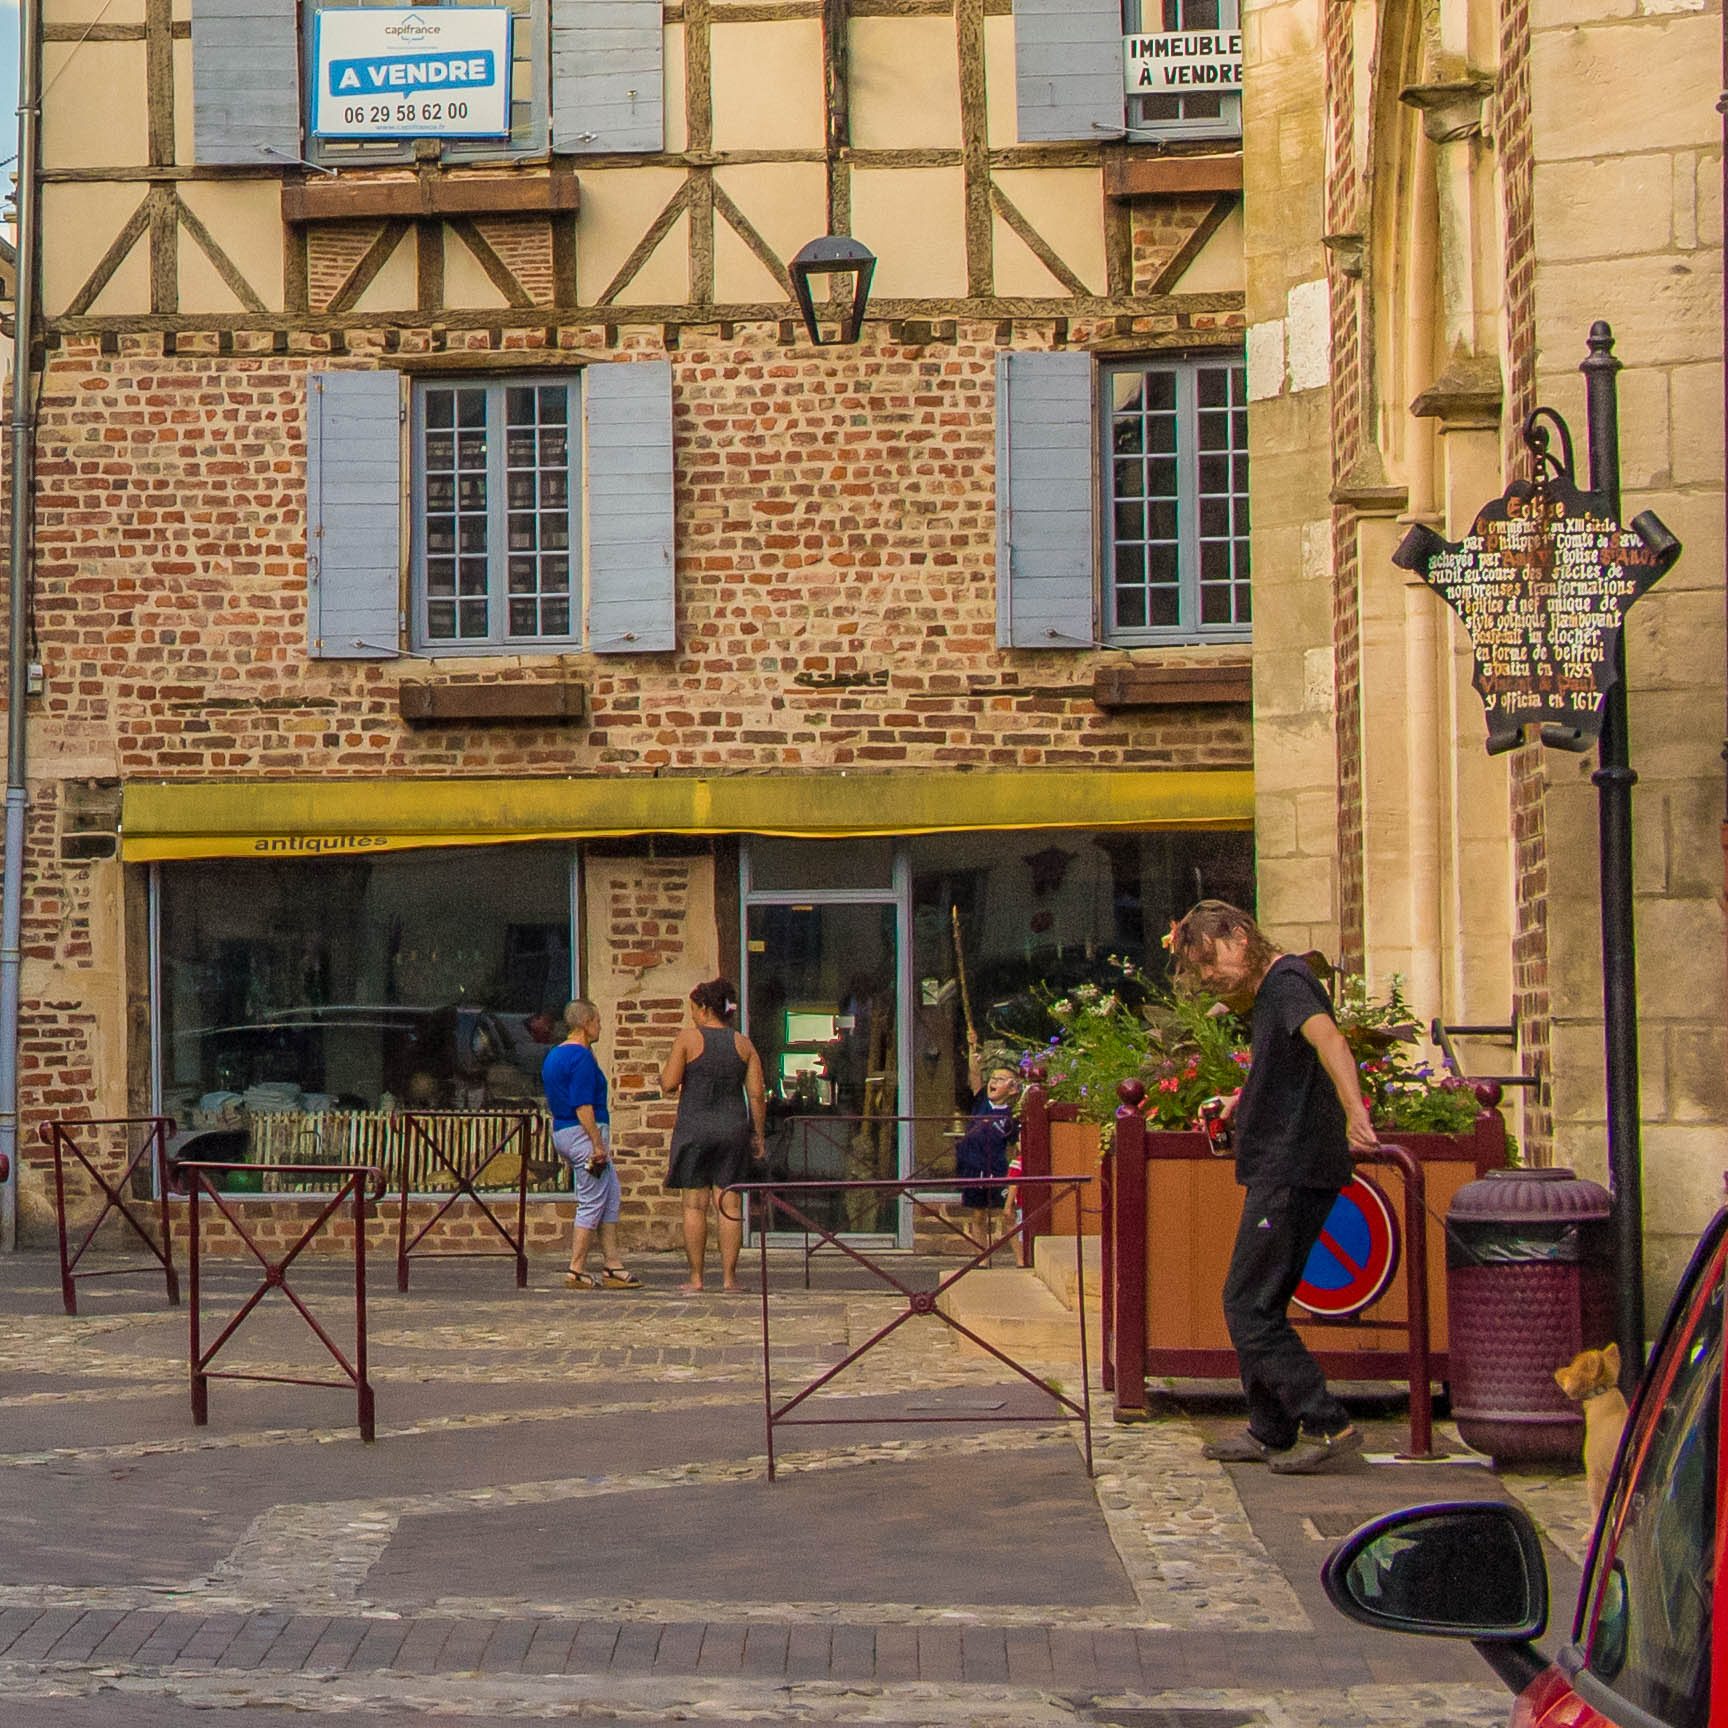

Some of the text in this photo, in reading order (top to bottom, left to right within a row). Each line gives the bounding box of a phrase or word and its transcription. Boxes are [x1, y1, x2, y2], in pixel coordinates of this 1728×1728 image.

[384, 24, 441, 36] capifrance
[1130, 35, 1242, 59] IMMEUBLE
[338, 58, 486, 89] A VENDRE
[1138, 60, 1242, 86] À VENDRE
[344, 102, 468, 124] 06 29 58 62 00
[1460, 536, 1485, 553] par
[1478, 552, 1501, 571] par
[1482, 568, 1517, 582] cours
[1607, 562, 1623, 578] de
[1519, 596, 1540, 614] nef
[1547, 597, 1591, 614] unique
[1600, 594, 1618, 611] de
[1476, 642, 1605, 664] en forme de beffroi
[1537, 662, 1553, 676] en
[1562, 662, 1593, 678] 1793
[1484, 694, 1497, 711] y
[1548, 693, 1565, 708] en
[1570, 692, 1604, 712] 1617
